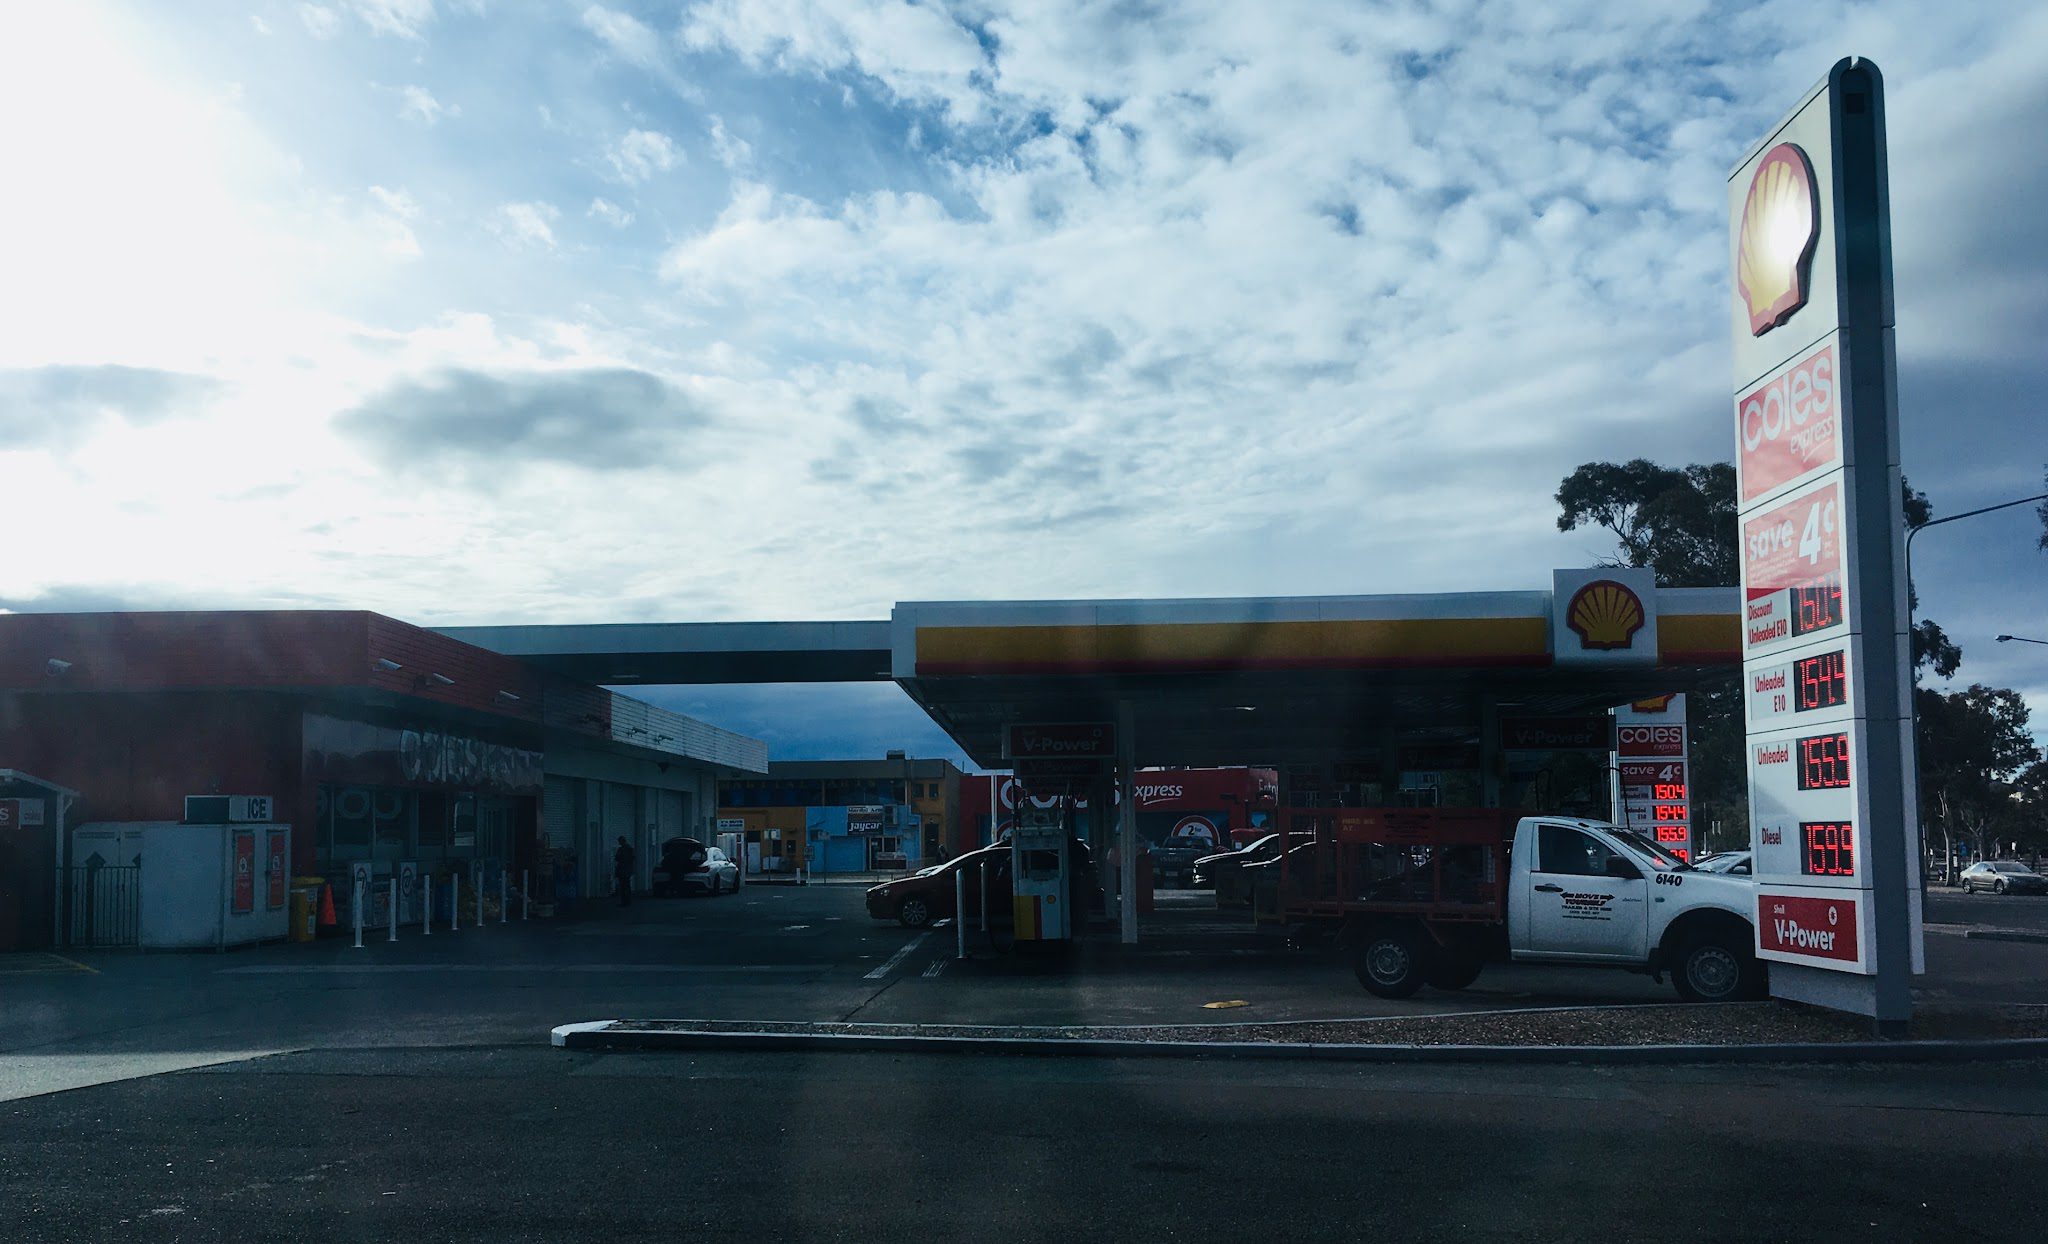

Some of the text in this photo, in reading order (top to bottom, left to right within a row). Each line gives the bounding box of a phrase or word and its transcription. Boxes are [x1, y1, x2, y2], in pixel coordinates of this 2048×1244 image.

[1743, 357, 1832, 452] coles
[1790, 416, 1834, 457] express
[1749, 519, 1794, 562] save
[1748, 600, 1773, 621] Discount
[1749, 618, 1787, 645] Unleaded E10
[1754, 669, 1785, 693] Unleaded
[1773, 694, 1786, 713] E10
[1023, 737, 1099, 751] V-Power
[1619, 727, 1682, 744] coles
[1757, 743, 1789, 766] Unleaded
[1622, 765, 1655, 775] save
[1134, 784, 1184, 801] xpress
[247, 798, 267, 818] ICE
[1761, 826, 1782, 846] Diesel
[1655, 873, 1683, 887] 6140
[1774, 918, 1836, 952] V-Power
